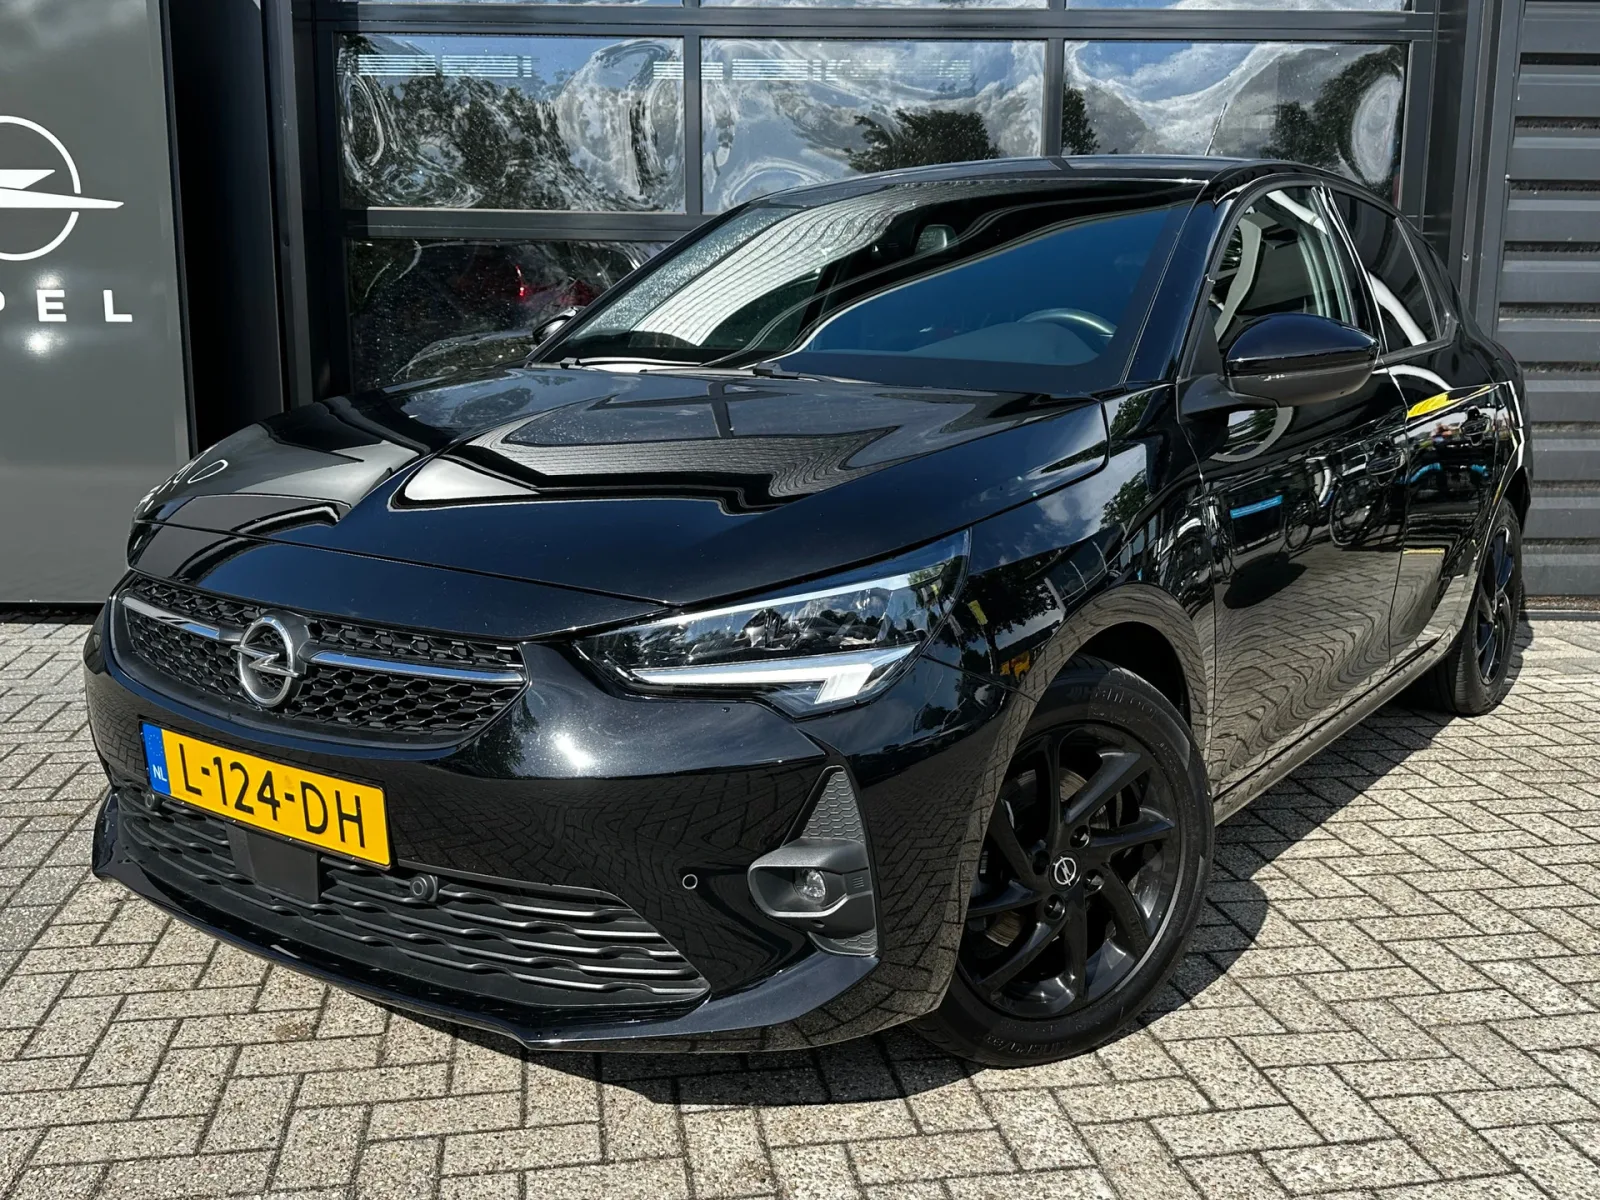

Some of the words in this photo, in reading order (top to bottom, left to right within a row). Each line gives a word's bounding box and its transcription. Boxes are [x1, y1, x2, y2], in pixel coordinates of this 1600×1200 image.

[0, 289, 133, 322] EL
[152, 764, 168, 782] NL
[178, 743, 366, 849] L-124-DH
